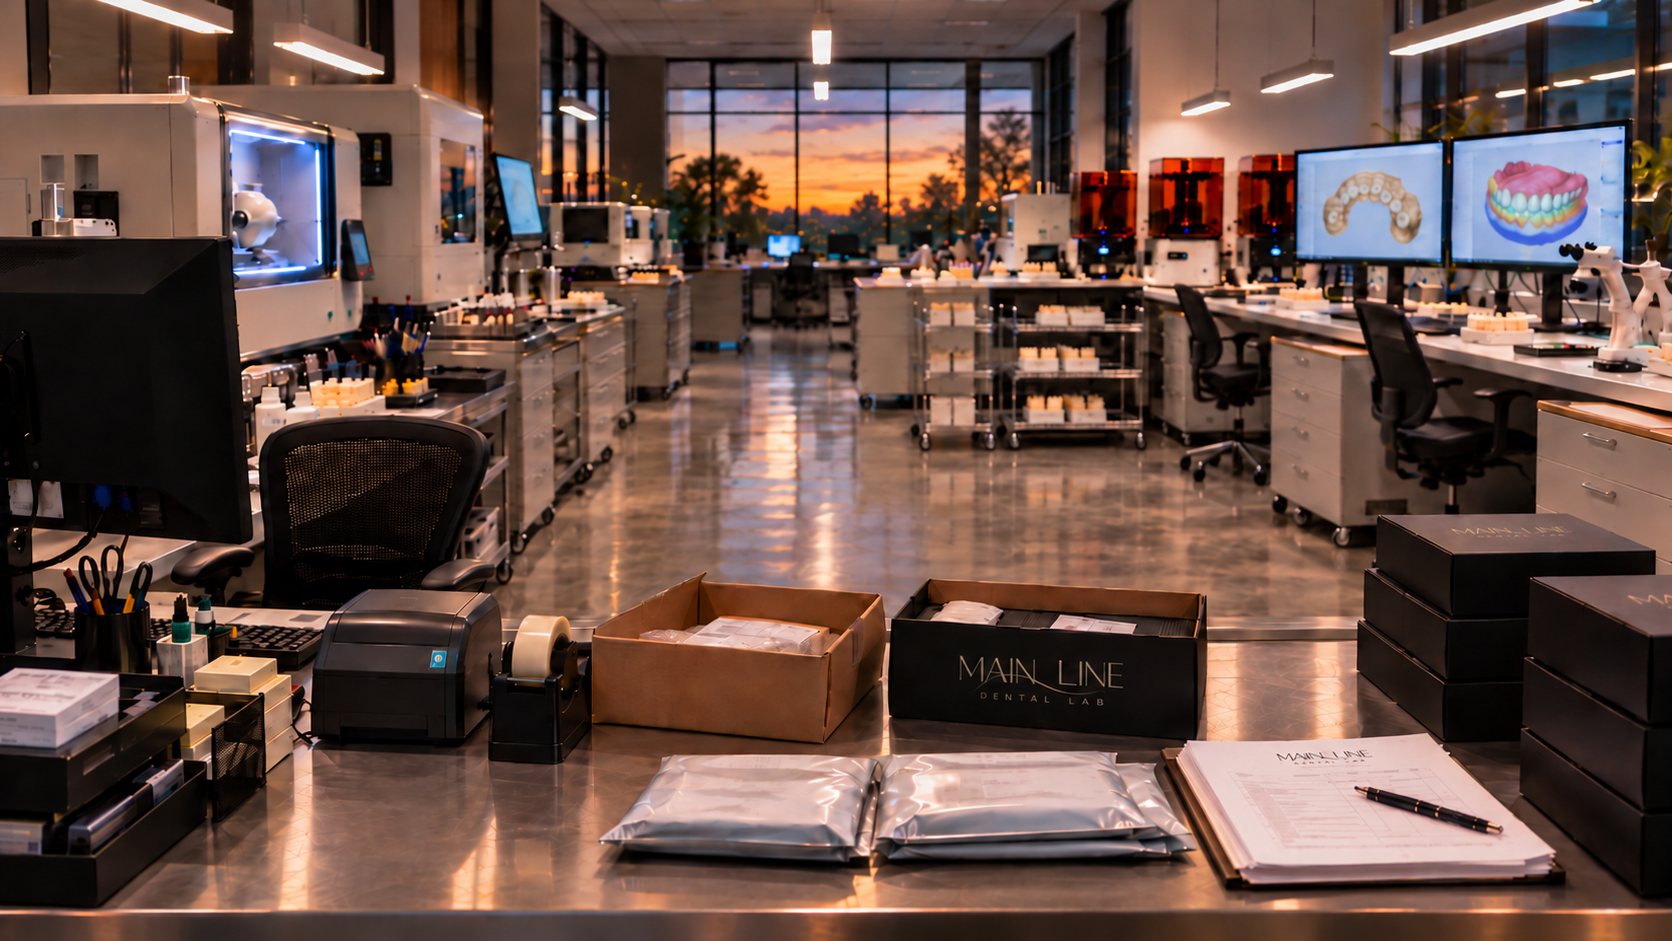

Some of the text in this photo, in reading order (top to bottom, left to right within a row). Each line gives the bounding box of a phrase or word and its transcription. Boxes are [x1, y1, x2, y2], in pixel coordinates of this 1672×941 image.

[958, 655, 1124, 689] MAIN LINE
[979, 691, 1104, 707] DENTAL LAB
[1276, 752, 1324, 761] MAIN
